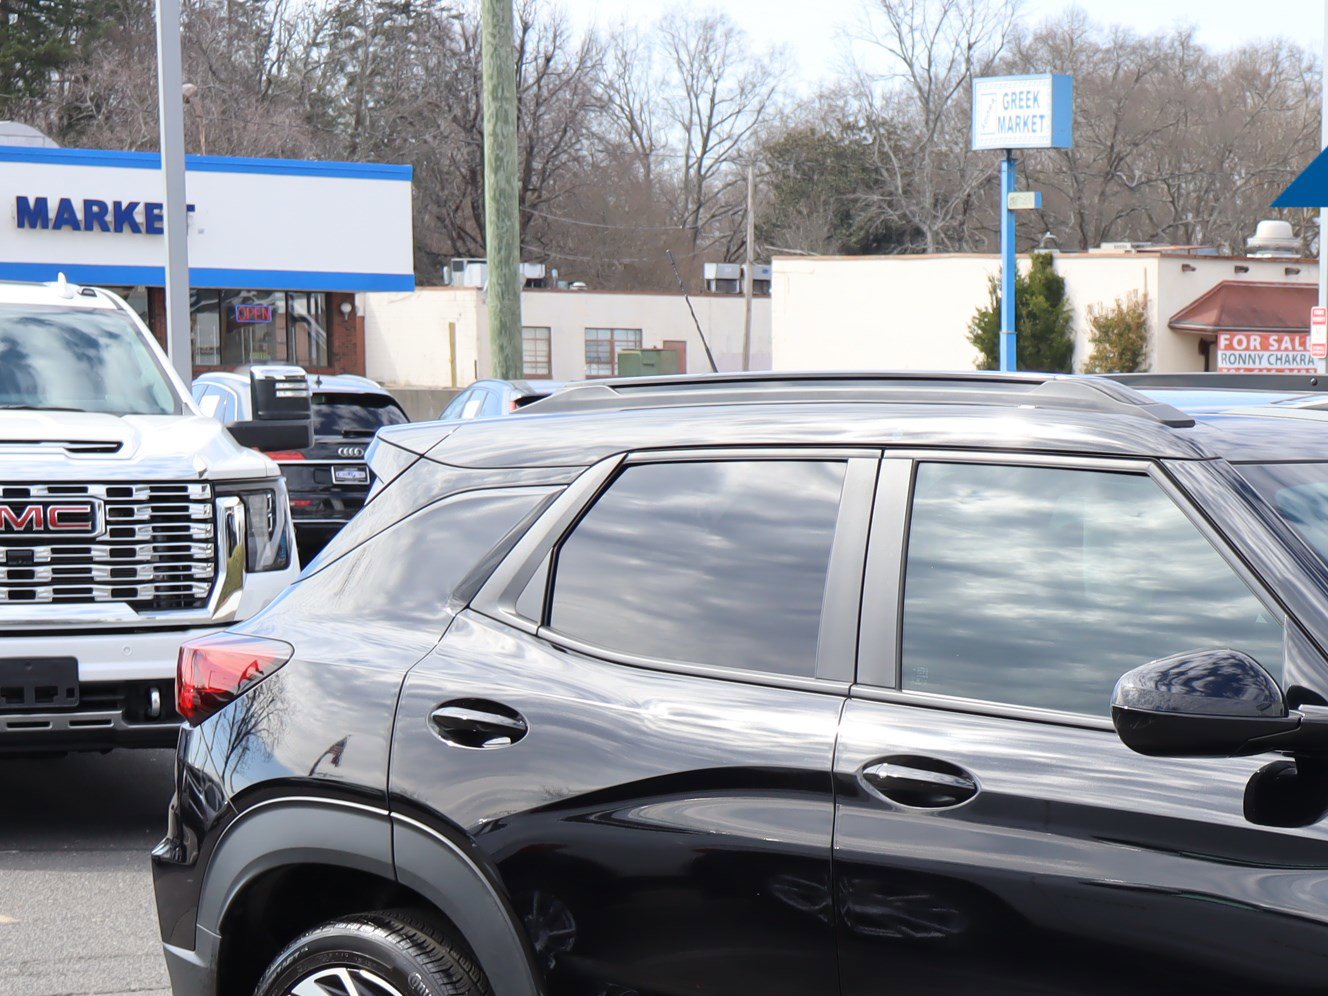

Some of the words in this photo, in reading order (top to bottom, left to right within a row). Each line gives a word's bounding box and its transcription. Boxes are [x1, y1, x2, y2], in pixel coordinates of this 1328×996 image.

[1002, 90, 1041, 110] GREEK
[997, 114, 1046, 133] MARKET
[16, 195, 196, 235] MARKE
[238, 305, 271, 321] OPEN
[1220, 334, 1261, 350] FOR
[1221, 353, 1264, 366] RONNY
